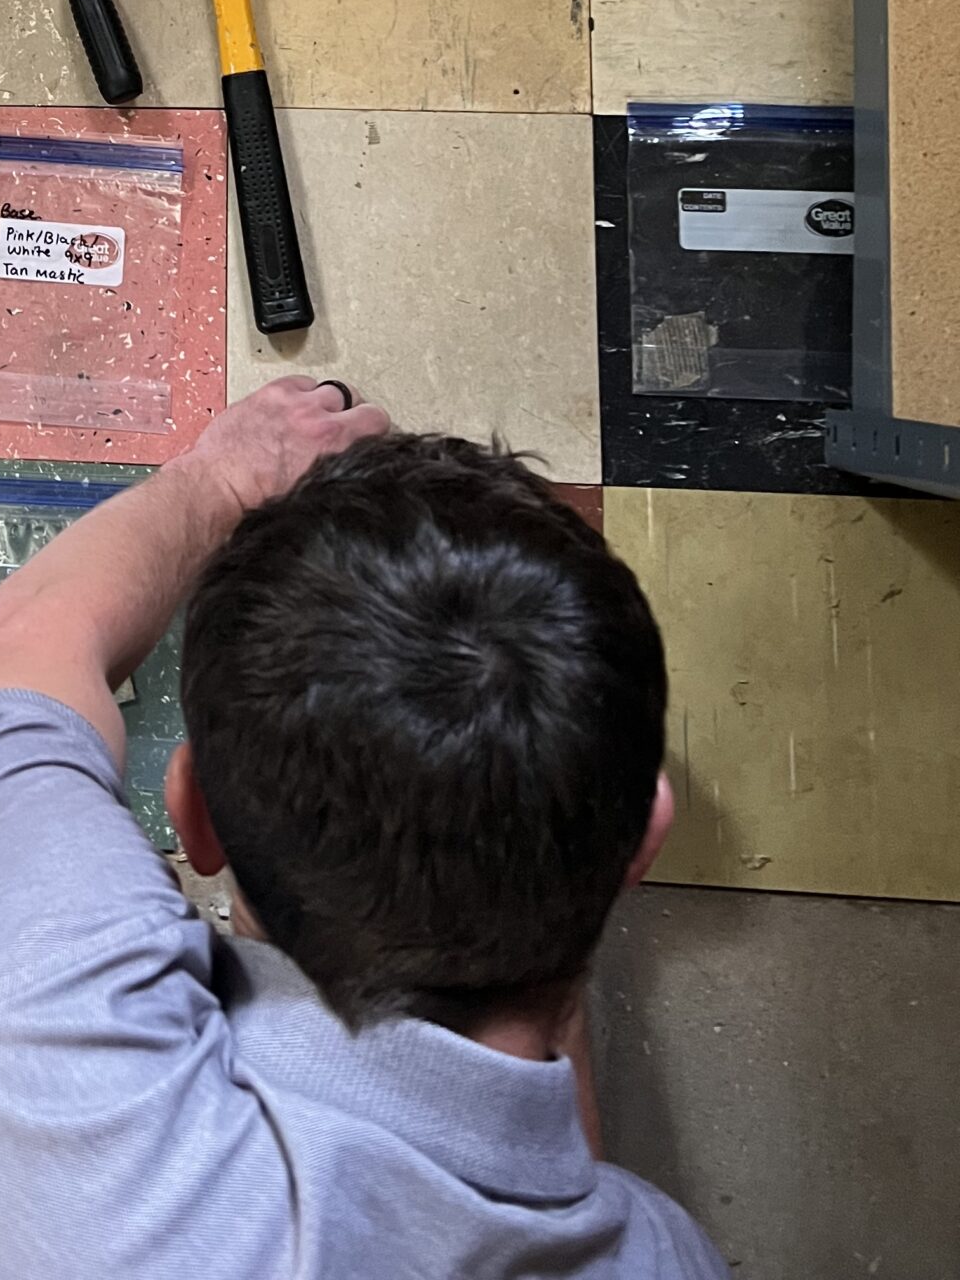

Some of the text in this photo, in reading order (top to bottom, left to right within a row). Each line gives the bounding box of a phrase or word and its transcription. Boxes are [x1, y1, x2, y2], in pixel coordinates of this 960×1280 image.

[0, 202, 42, 220] Base
[811, 207, 851, 221] Great
[821, 221, 852, 230] Value
[64, 250, 93, 267] 9x9
